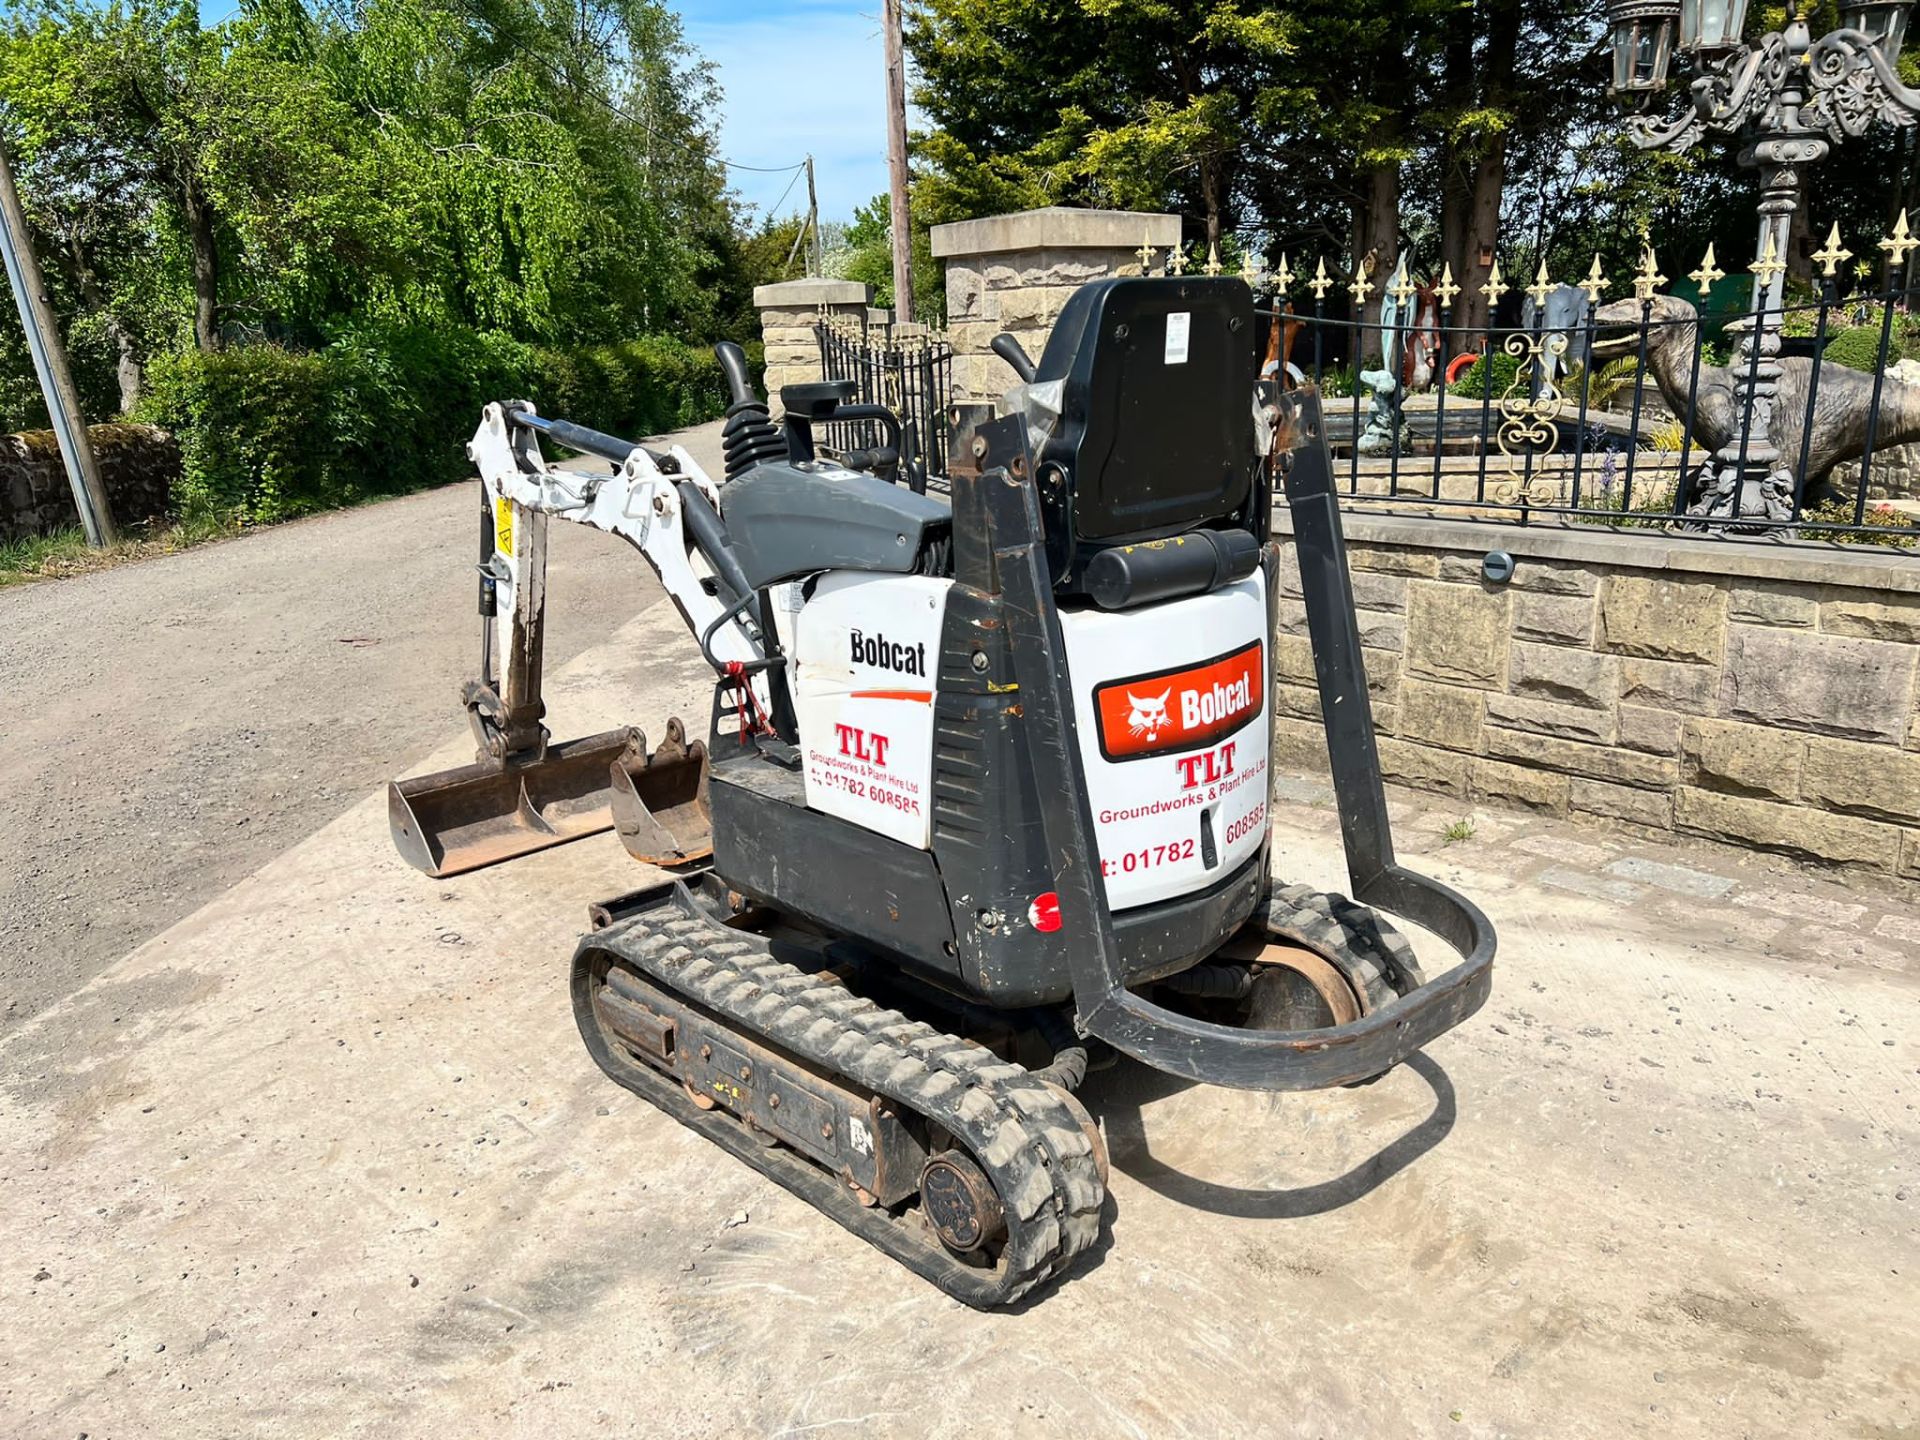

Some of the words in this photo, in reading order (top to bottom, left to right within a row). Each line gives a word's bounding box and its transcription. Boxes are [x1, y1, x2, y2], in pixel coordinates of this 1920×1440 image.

[851, 631, 926, 677] Bobcat
[1180, 671, 1251, 730] Bobcat
[835, 723, 889, 767] TLT
[1176, 741, 1235, 790] TLT
[810, 749, 859, 774] Groundworks
[860, 765, 866, 776] &
[867, 765, 887, 782] Plant
[888, 773, 904, 789] Hire
[905, 780, 919, 794] Ltd
[825, 771, 865, 797] 01782
[869, 786, 920, 816] 608585
[1099, 793, 1203, 824] Groundworks
[1208, 788, 1216, 801] &
[1219, 776, 1241, 796] Plant
[1241, 766, 1255, 781] Hire
[1255, 757, 1266, 773] Ltd
[1101, 857, 1117, 877] t:
[1122, 838, 1194, 873] 01782
[1226, 802, 1265, 844] 608585
